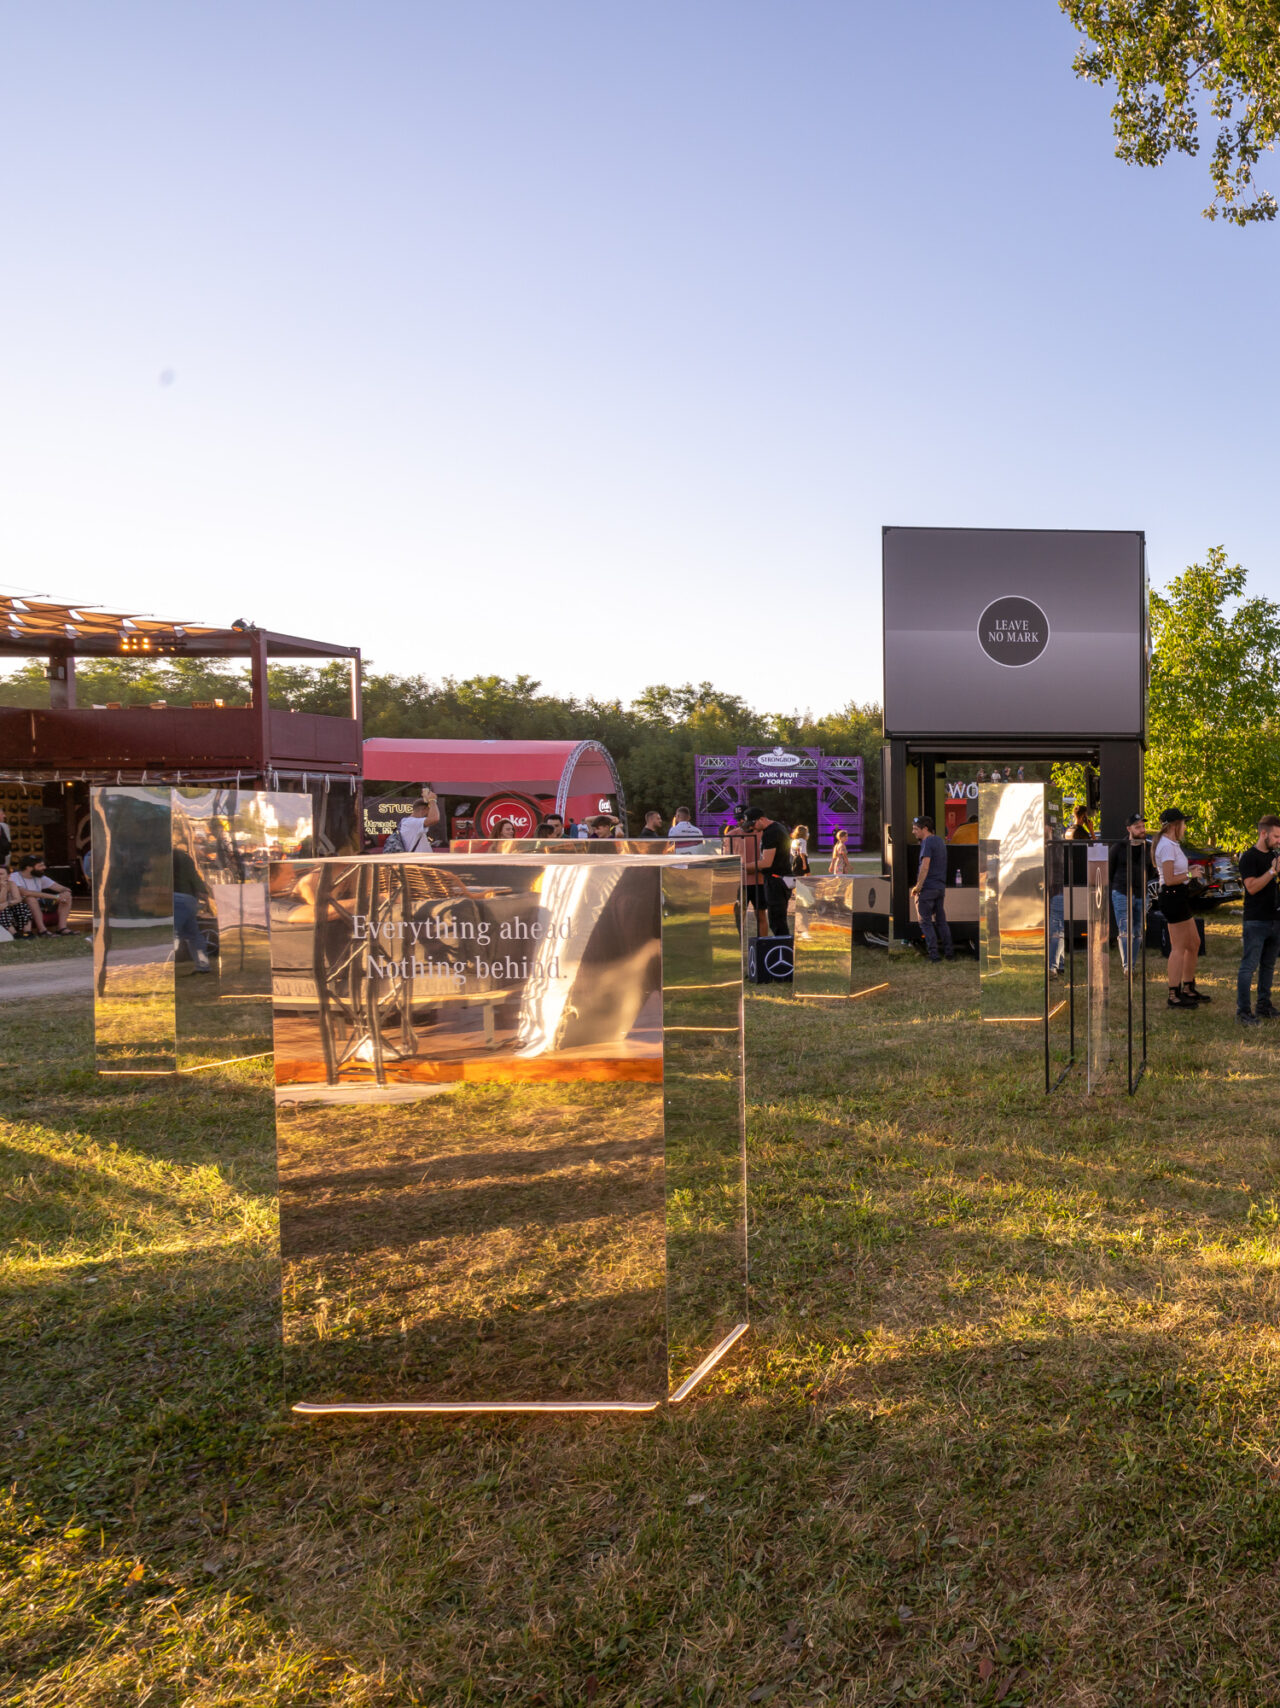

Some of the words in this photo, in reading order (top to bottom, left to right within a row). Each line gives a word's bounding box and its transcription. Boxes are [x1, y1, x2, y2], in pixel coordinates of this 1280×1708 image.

[995, 619, 1029, 631] LEAVE
[988, 631, 1004, 642] NO
[1007, 631, 1039, 643] MARK
[489, 814, 529, 827] Cke
[352, 915, 491, 945] Everything
[367, 955, 467, 985] Nothing
[474, 954, 568, 980] behind.
